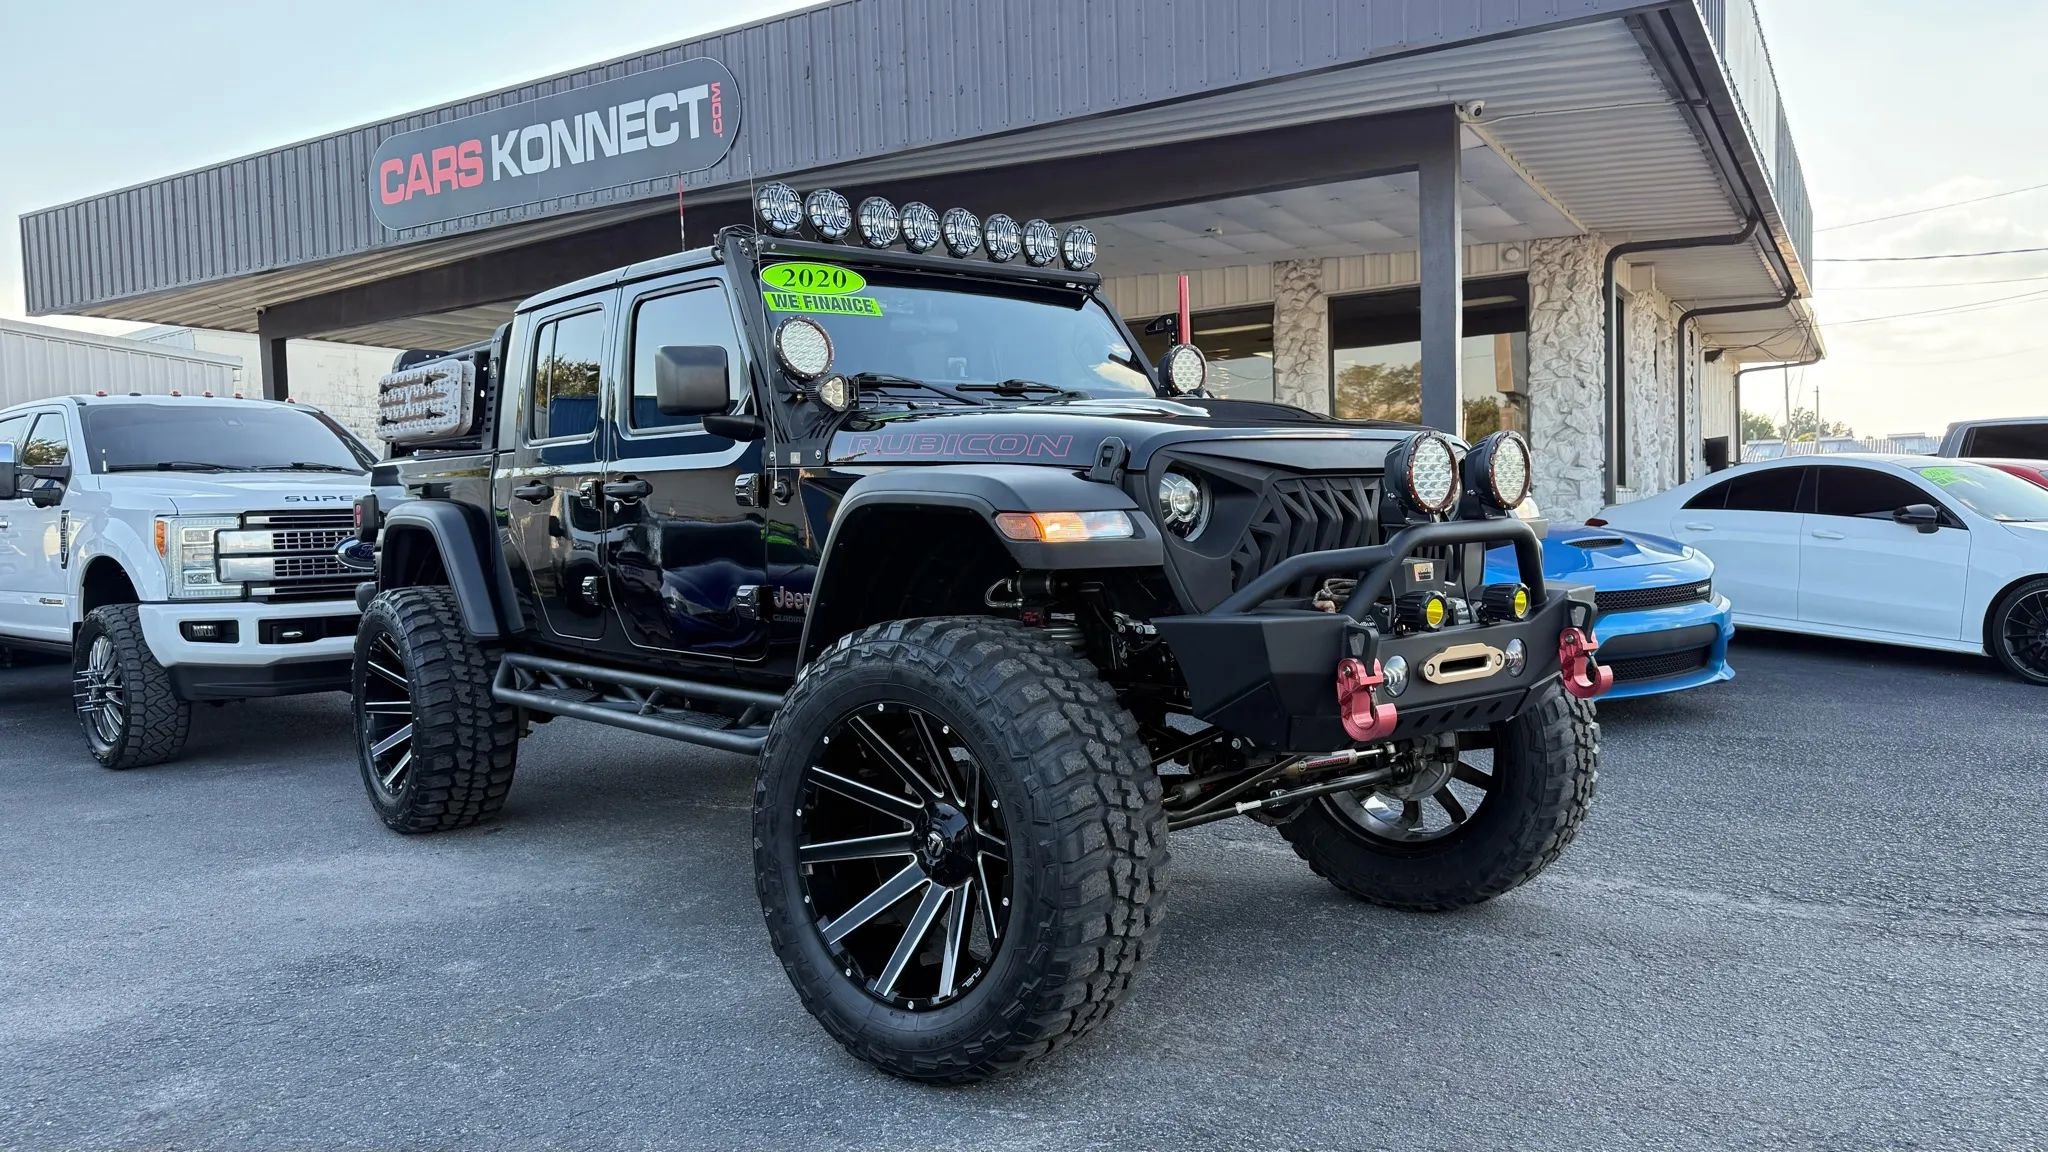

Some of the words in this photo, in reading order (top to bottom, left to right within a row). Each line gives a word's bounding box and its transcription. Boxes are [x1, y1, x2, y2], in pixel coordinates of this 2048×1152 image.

[711, 81, 723, 138] .COM
[379, 139, 484, 206] CARS
[491, 84, 709, 182] KONNECT
[781, 268, 847, 289] 2020
[771, 293, 801, 310] WE
[802, 295, 874, 314] FINANCE
[848, 433, 1074, 457] RUBICON
[773, 585, 812, 615] Jeep
